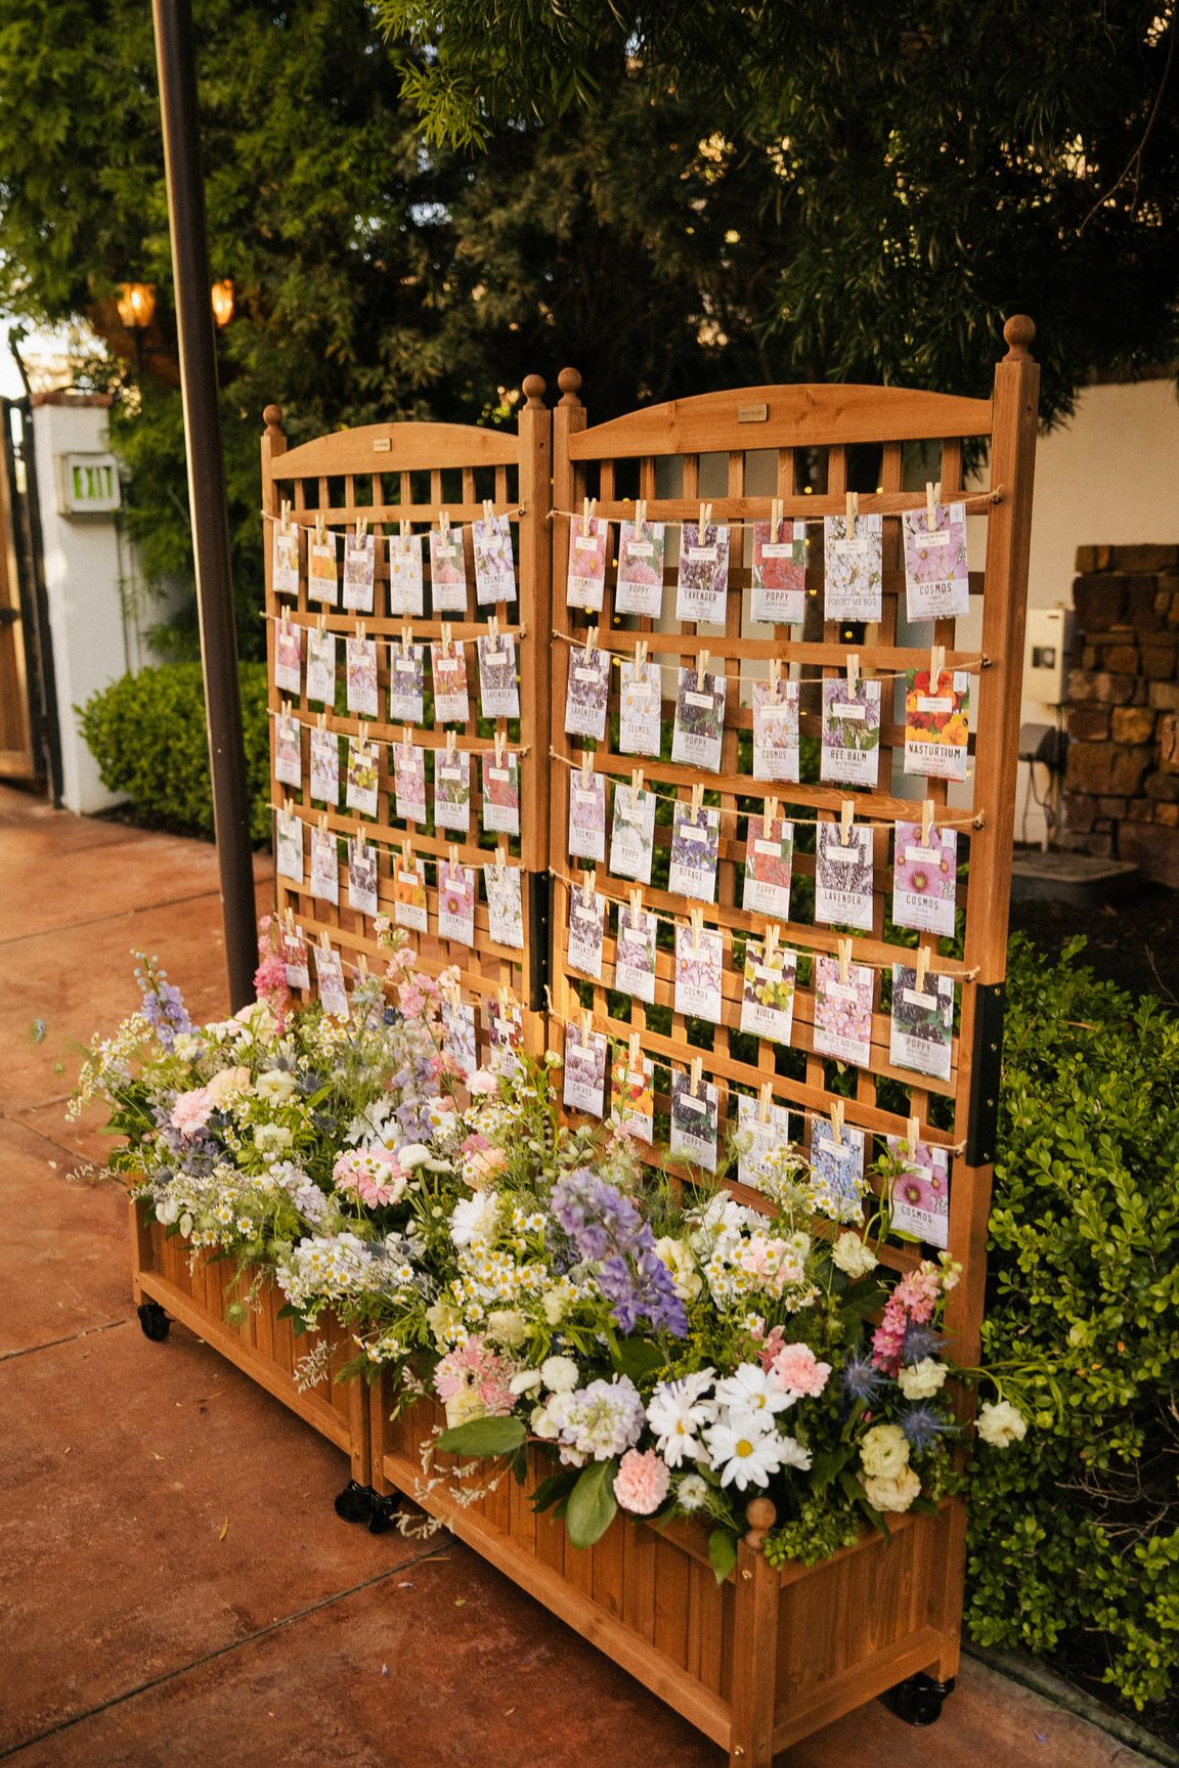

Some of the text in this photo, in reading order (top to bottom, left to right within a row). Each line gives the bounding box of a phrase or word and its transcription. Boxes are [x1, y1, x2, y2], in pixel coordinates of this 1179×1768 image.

[484, 574, 505, 584] COSMOS
[628, 584, 650, 594] POPPY
[920, 583, 952, 595] COSMOS
[684, 591, 718, 602] LAVENDER
[766, 591, 789, 601] POPPY
[828, 598, 876, 606] FORGET ME NOT
[486, 690, 510, 698] LAVENDER
[571, 705, 598, 718] LAVENDER
[628, 724, 650, 734] COSMOS
[685, 735, 707, 747] POPPY
[762, 750, 787, 760] COSMOS
[830, 750, 867, 762] BEE BALM
[908, 744, 961, 758] NASTURTIUM
[679, 867, 703, 881] BORAGE
[756, 883, 776, 896] POPPY
[824, 891, 862, 905] LAVENDER
[906, 894, 940, 910] COSMOS
[684, 986, 709, 999] COSMOS
[756, 1007, 775, 1020] VIOLA
[906, 1037, 931, 1051] POPPY
[572, 1084, 593, 1097] CHIVES
[682, 1134, 703, 1147] POPPY
[748, 1158, 774, 1176] CSMOS
[901, 1205, 933, 1223] COSMOS
